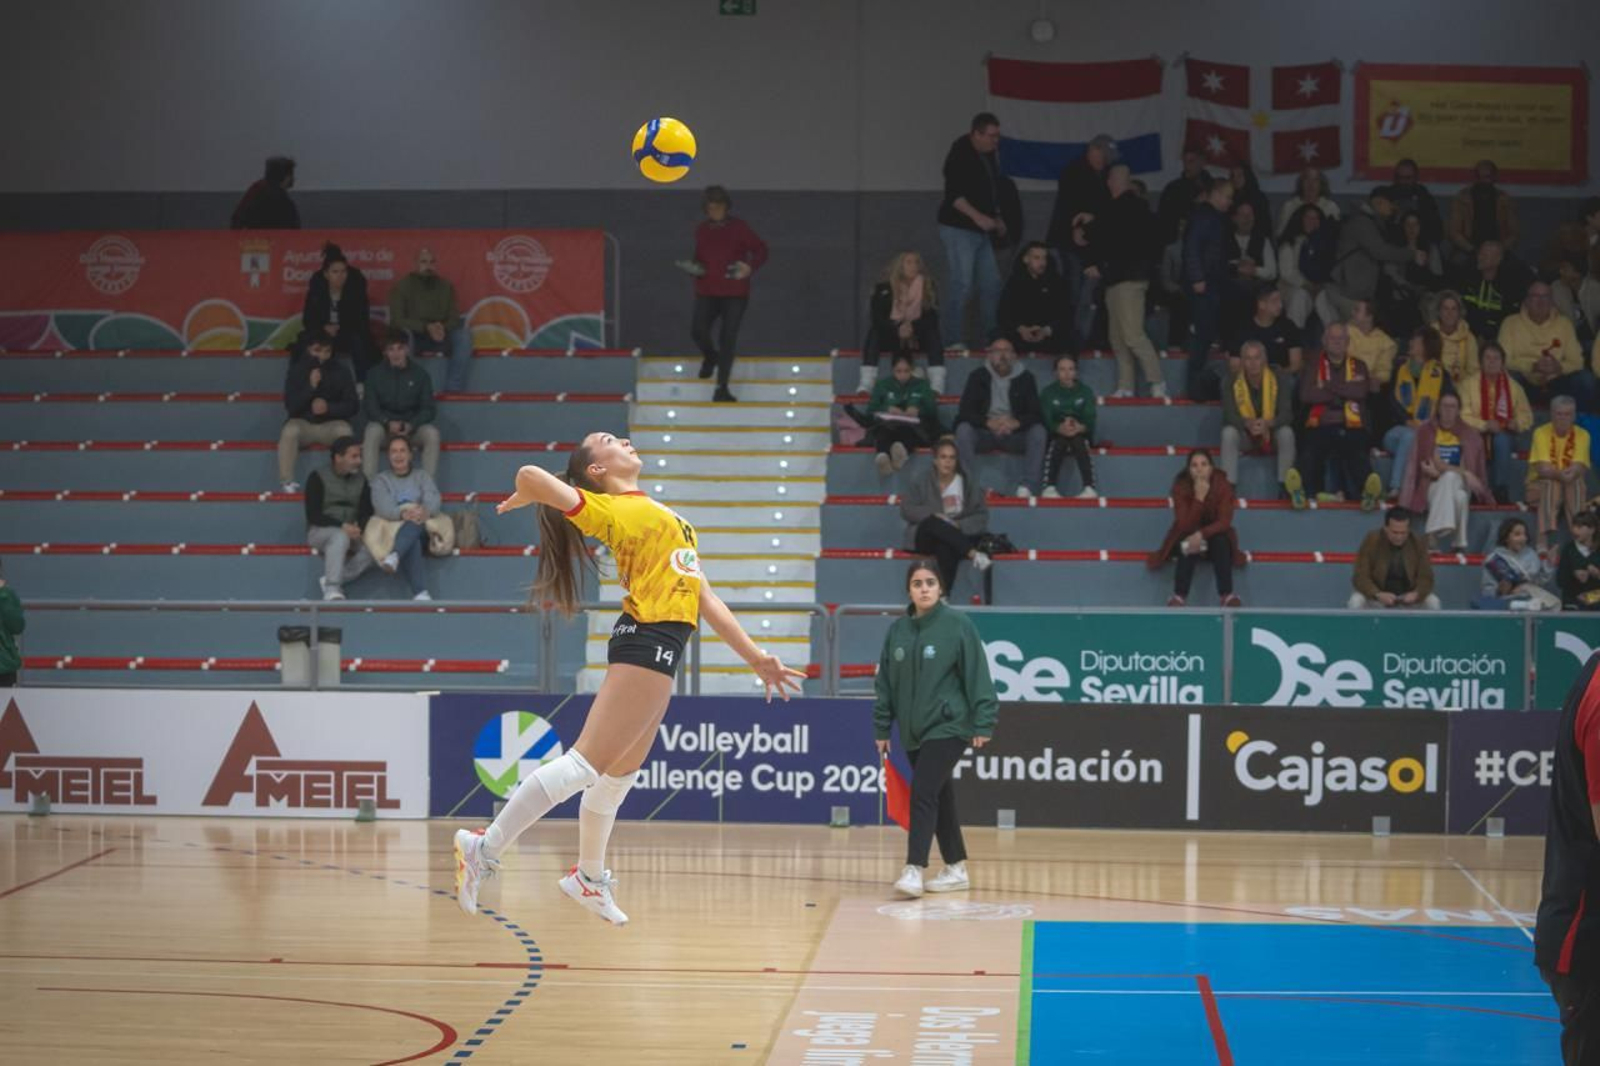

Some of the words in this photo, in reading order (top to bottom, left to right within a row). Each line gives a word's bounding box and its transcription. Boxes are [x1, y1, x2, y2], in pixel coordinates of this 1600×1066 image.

[655, 645, 674, 666] 14
[1080, 650, 1204, 675] Diputación
[1384, 652, 1505, 677] Diputación
[1080, 676, 1204, 704] Sevilla
[1384, 679, 1505, 709] Sevilla
[660, 723, 808, 759] Volleyball
[634, 761, 743, 797] allenge
[751, 765, 814, 797] Cup
[952, 747, 1162, 783] Fundación
[1234, 739, 1438, 806] Cajasol
